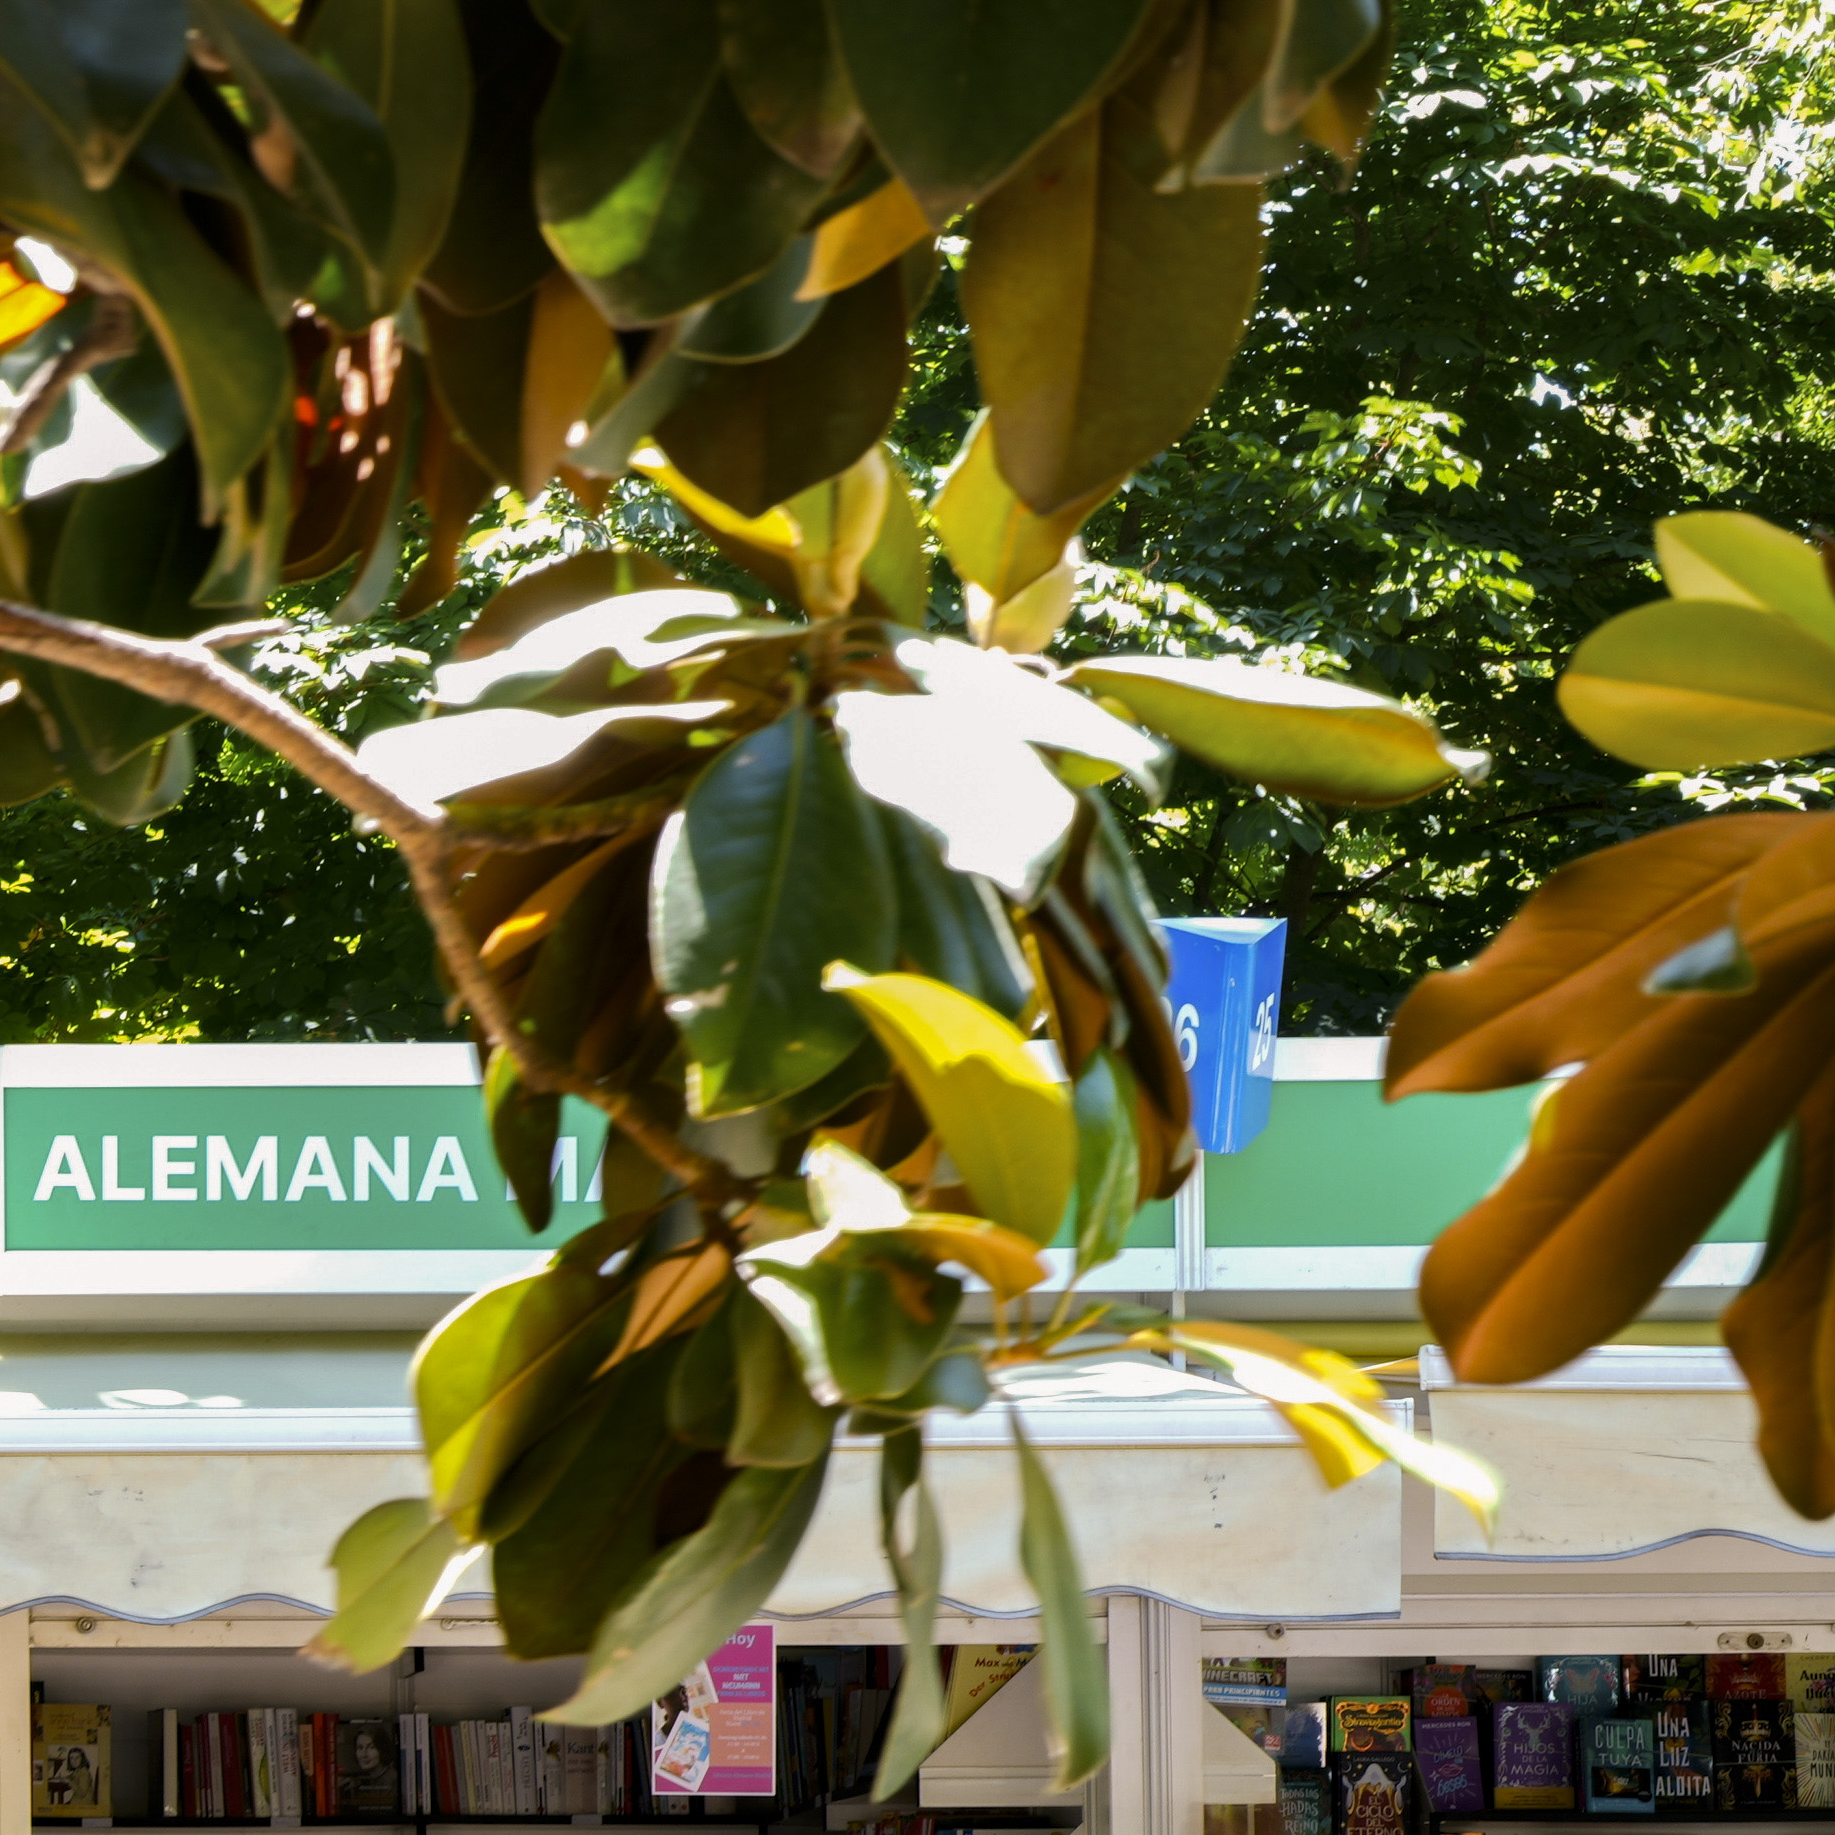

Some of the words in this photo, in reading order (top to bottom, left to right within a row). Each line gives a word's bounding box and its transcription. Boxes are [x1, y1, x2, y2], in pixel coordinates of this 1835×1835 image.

[1251, 992, 1275, 1072] 25
[32, 1135, 479, 1203] ALEMANA
[975, 1657, 1001, 1668] Max
[1648, 1653, 1679, 1677] UNA
[969, 1681, 986, 1698] Der
[1224, 1687, 1281, 1698] PRINCIPIANTES
[1724, 1688, 1767, 1699] AZOTE
[1430, 1698, 1461, 1706] ORDEN
[1657, 1710, 1690, 1738] UNA
[1594, 1725, 1646, 1750] CULPA
[567, 1741, 594, 1755] Kant
[1514, 1743, 1555, 1755] HIJOS
[1731, 1739, 1782, 1752] NACIDA
[1598, 1753, 1643, 1767] TUYA
[1659, 1741, 1691, 1768] LUZ
[1510, 1764, 1560, 1775] MAGIA
[1369, 1796, 1382, 1805] EL
[1279, 1800, 1318, 1818] HADAS
[1355, 1804, 1395, 1822] CICLO
[1365, 1818, 1385, 1828] DEL
